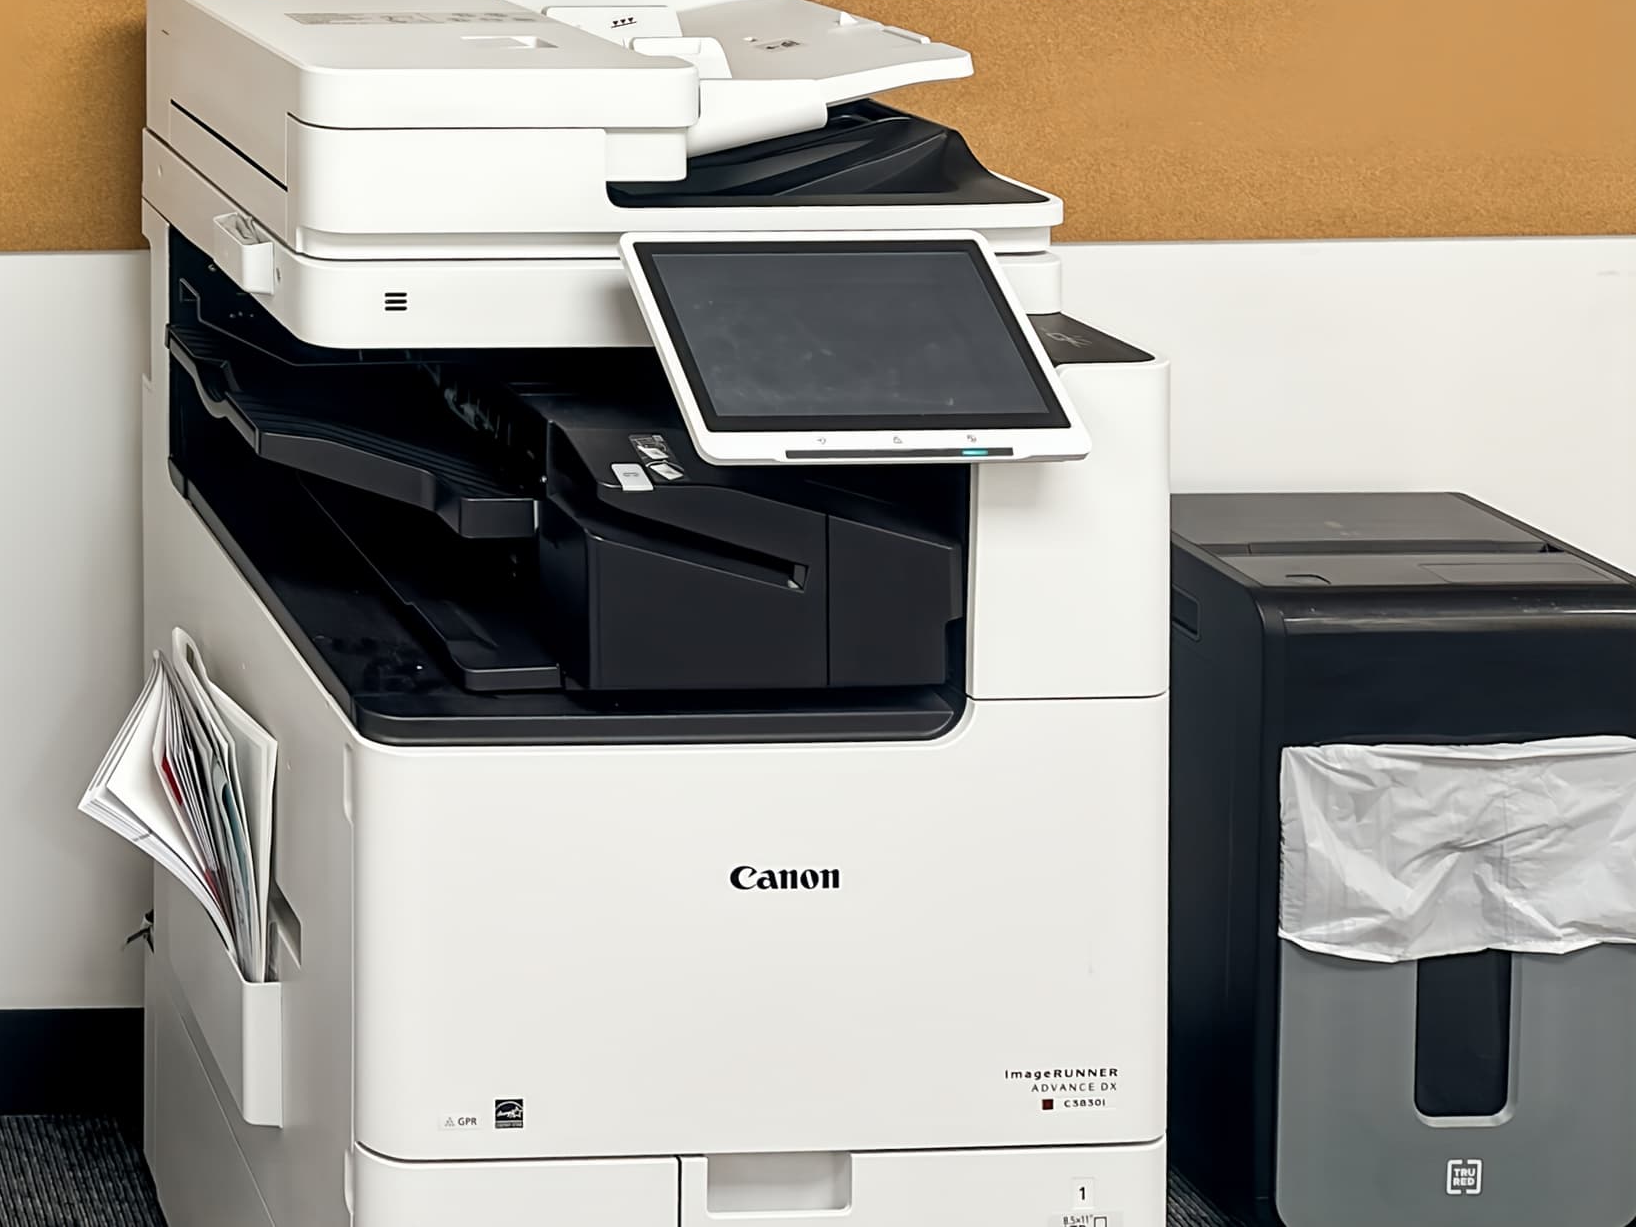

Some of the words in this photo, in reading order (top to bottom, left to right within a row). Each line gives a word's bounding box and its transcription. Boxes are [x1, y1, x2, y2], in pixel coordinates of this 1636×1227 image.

[730, 866, 839, 890] Canon
[1031, 1083, 1094, 1092] ADVANCE
[458, 1117, 477, 1126] GPR
[1454, 1168, 1476, 1178] TRU
[1453, 1177, 1476, 1187] RED
[1079, 1187, 1086, 1201] 1
